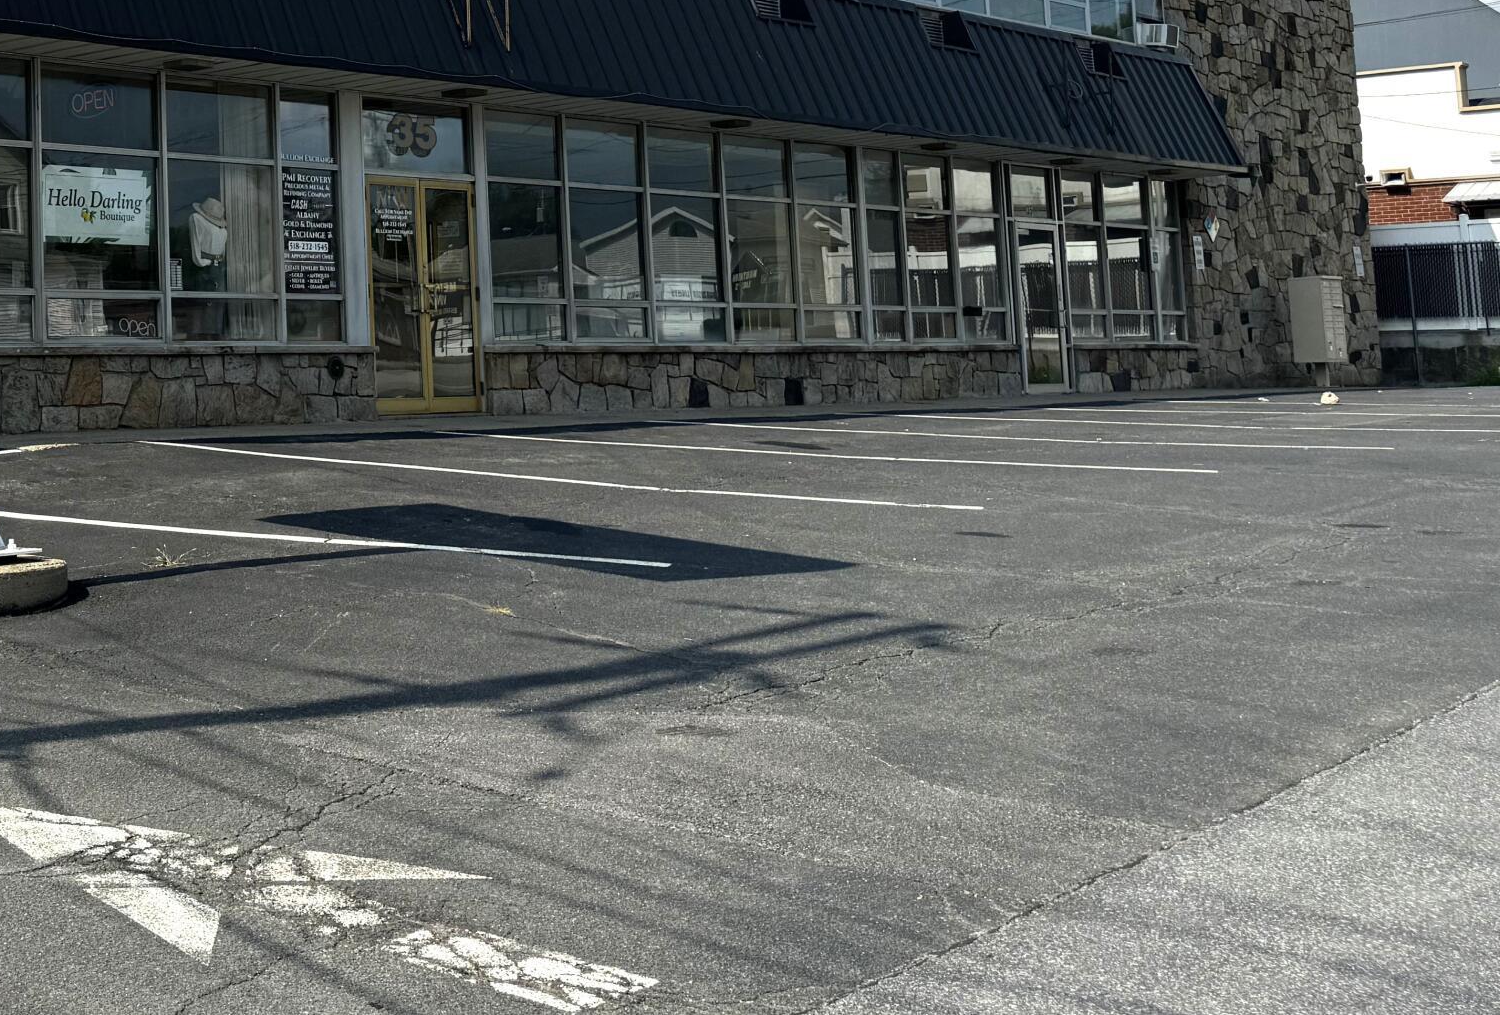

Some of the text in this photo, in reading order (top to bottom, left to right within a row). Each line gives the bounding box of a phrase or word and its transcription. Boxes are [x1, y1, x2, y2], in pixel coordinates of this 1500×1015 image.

[72, 88, 114, 113] OPEN
[387, 113, 437, 155] 35
[48, 188, 143, 214] Hello Darling
[291, 199, 308, 210] CASH
[99, 210, 135, 223] Boutique
[119, 317, 156, 337] open
